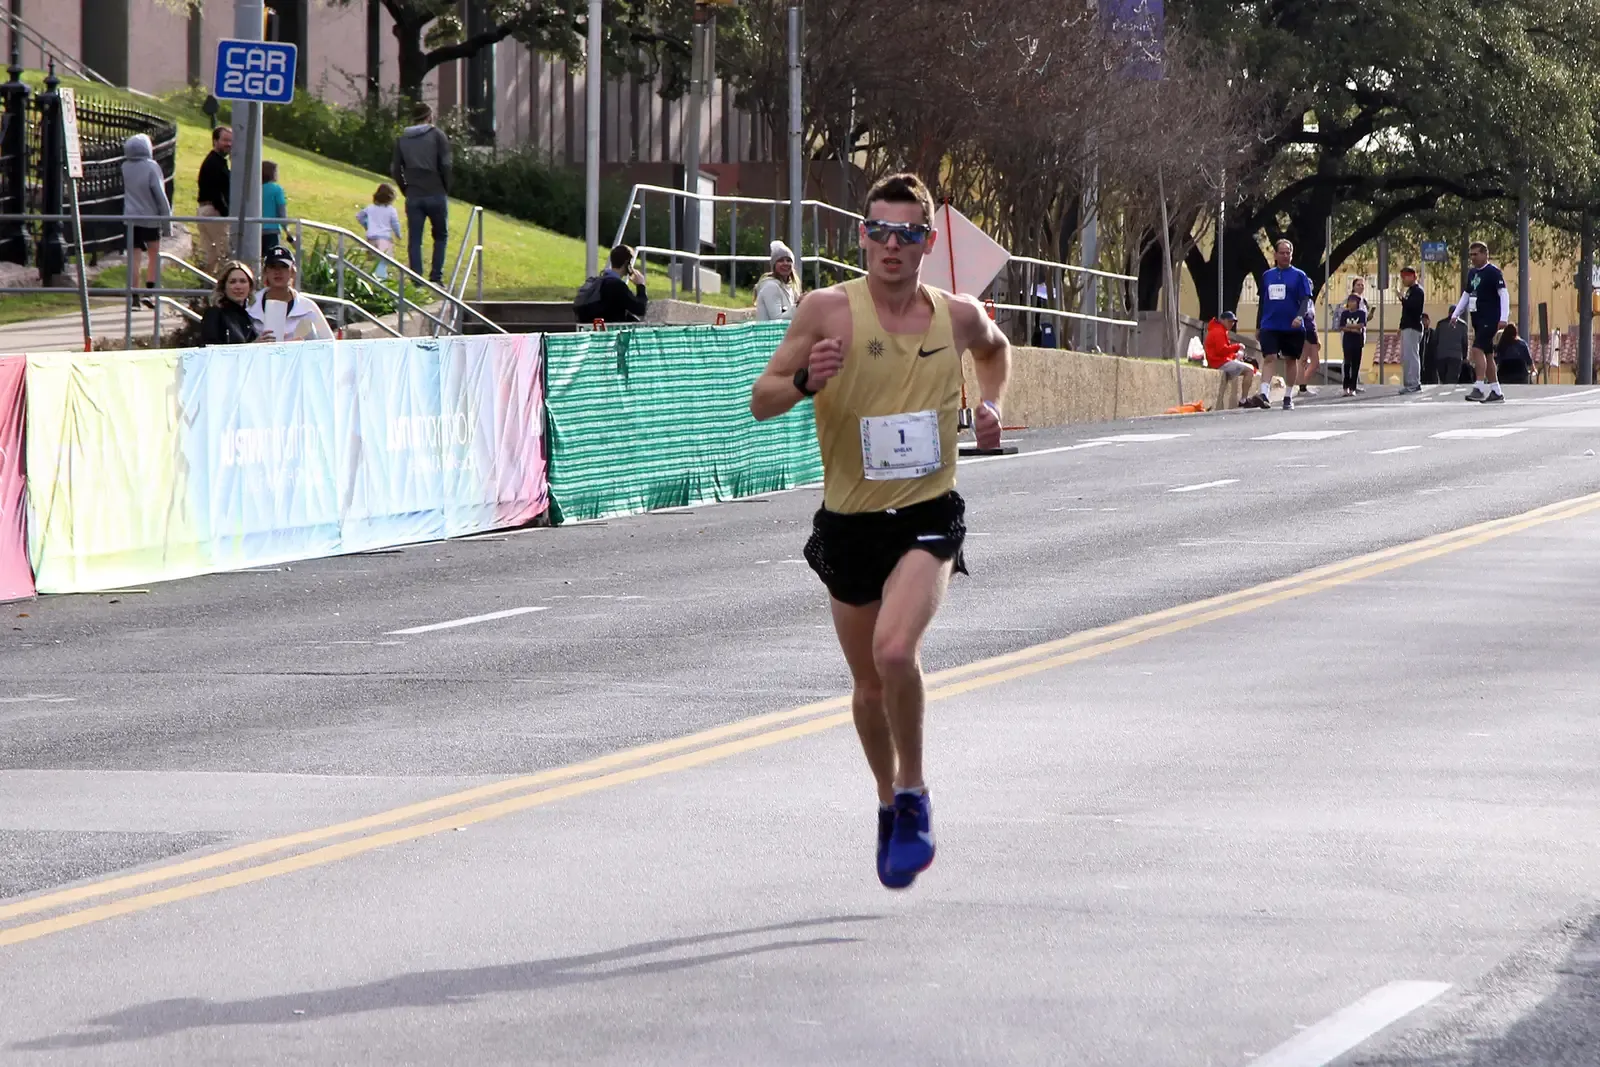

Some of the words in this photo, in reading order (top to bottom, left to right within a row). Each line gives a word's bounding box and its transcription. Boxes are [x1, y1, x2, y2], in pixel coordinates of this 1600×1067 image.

[226, 47, 286, 73] CAR
[223, 70, 284, 96] 2GO
[898, 429, 905, 444] 1
